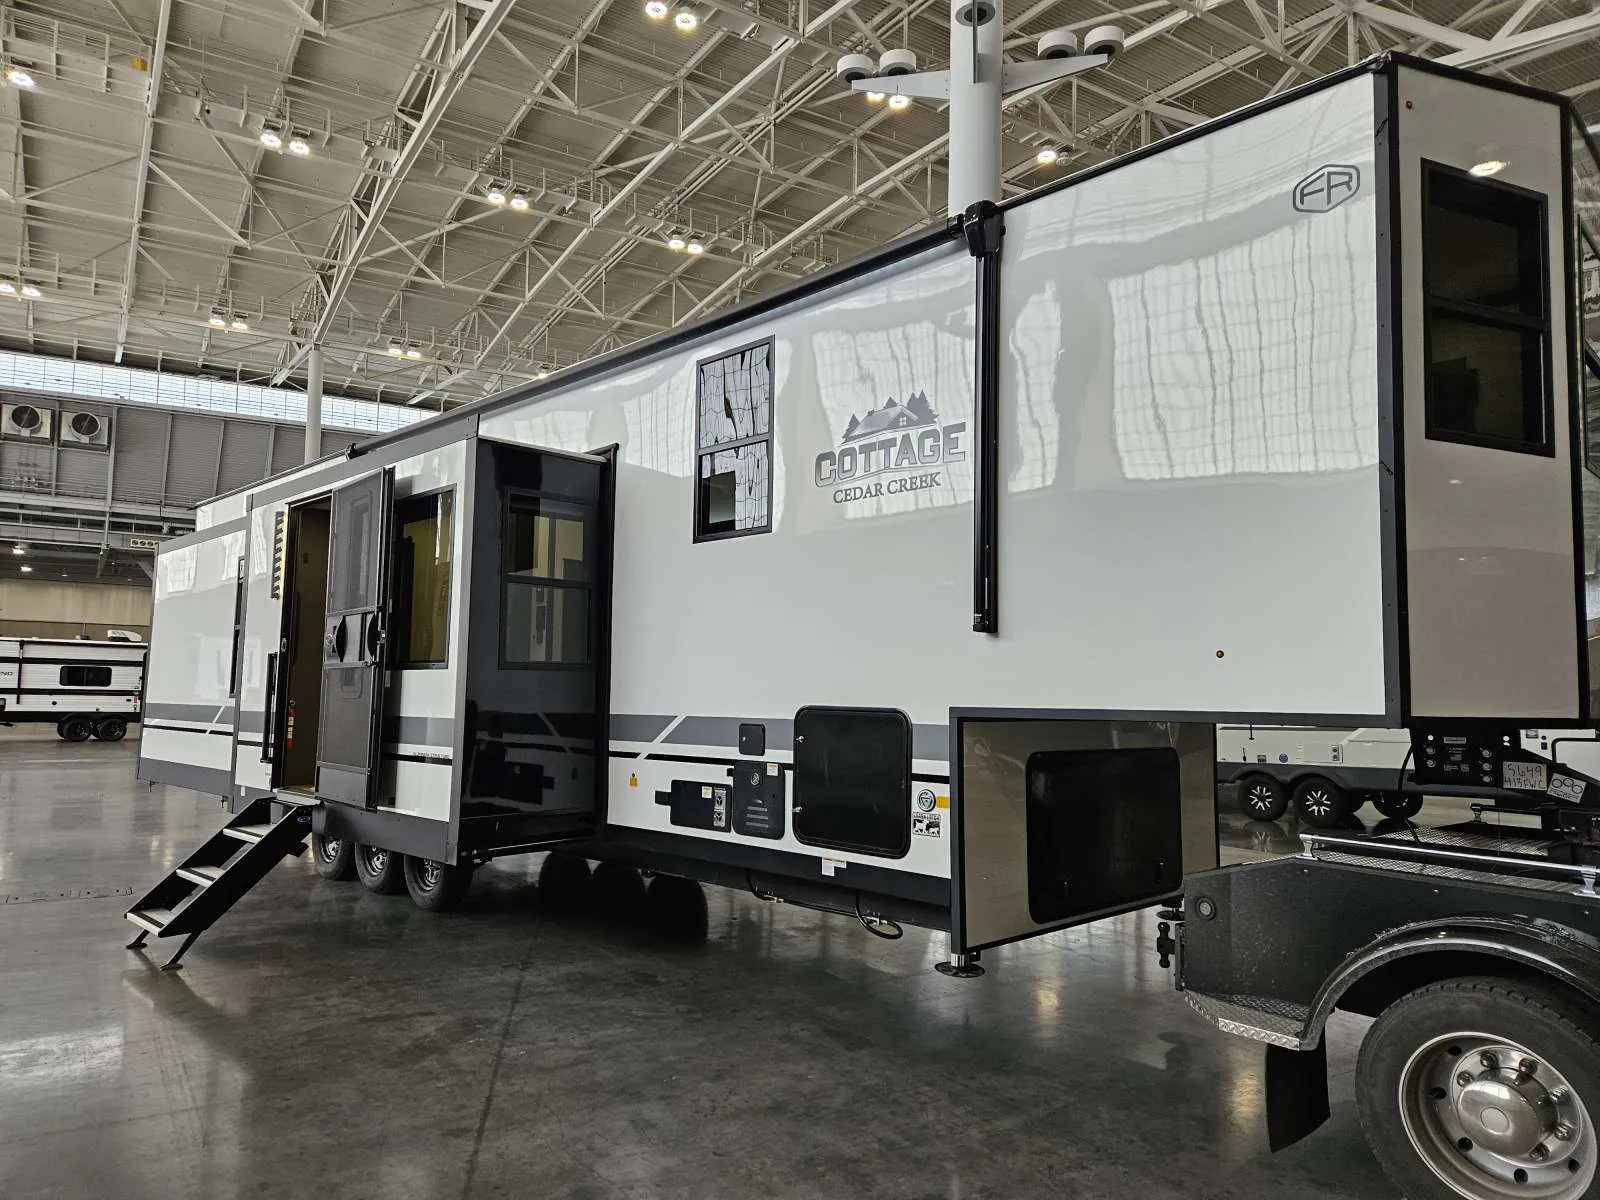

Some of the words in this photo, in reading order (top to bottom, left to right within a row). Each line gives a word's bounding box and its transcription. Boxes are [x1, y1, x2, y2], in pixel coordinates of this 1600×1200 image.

[1299, 171, 1353, 206] FR
[815, 422, 967, 488] COTTAGE
[833, 483, 885, 504] CEDAR
[886, 472, 941, 495] CREEK
